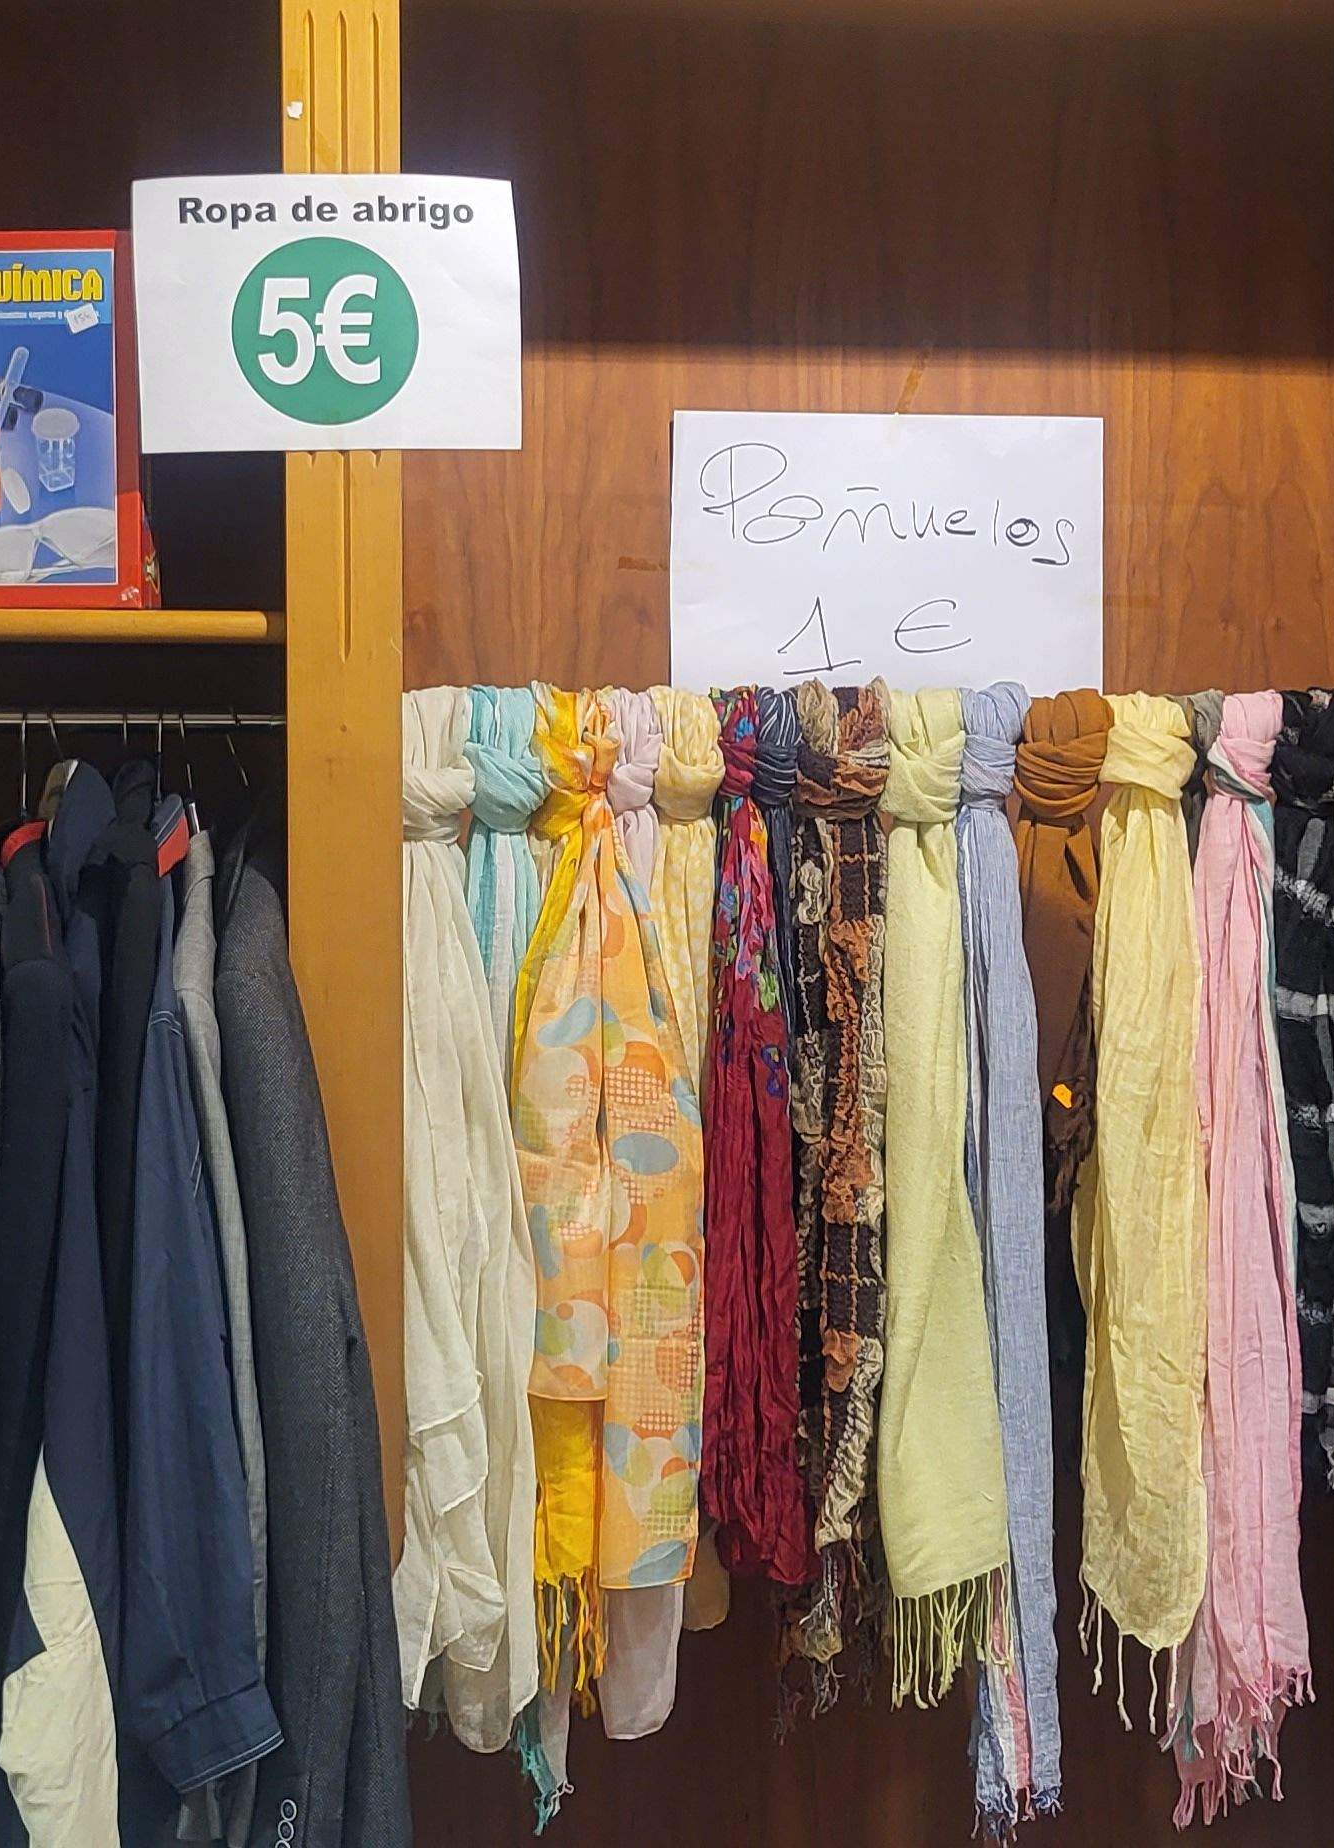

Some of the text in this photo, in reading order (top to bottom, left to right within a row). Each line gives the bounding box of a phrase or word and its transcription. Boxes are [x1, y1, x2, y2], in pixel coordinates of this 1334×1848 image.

[178, 195, 474, 230] Ropa de abrigo
[257, 274, 381, 386] 5€
